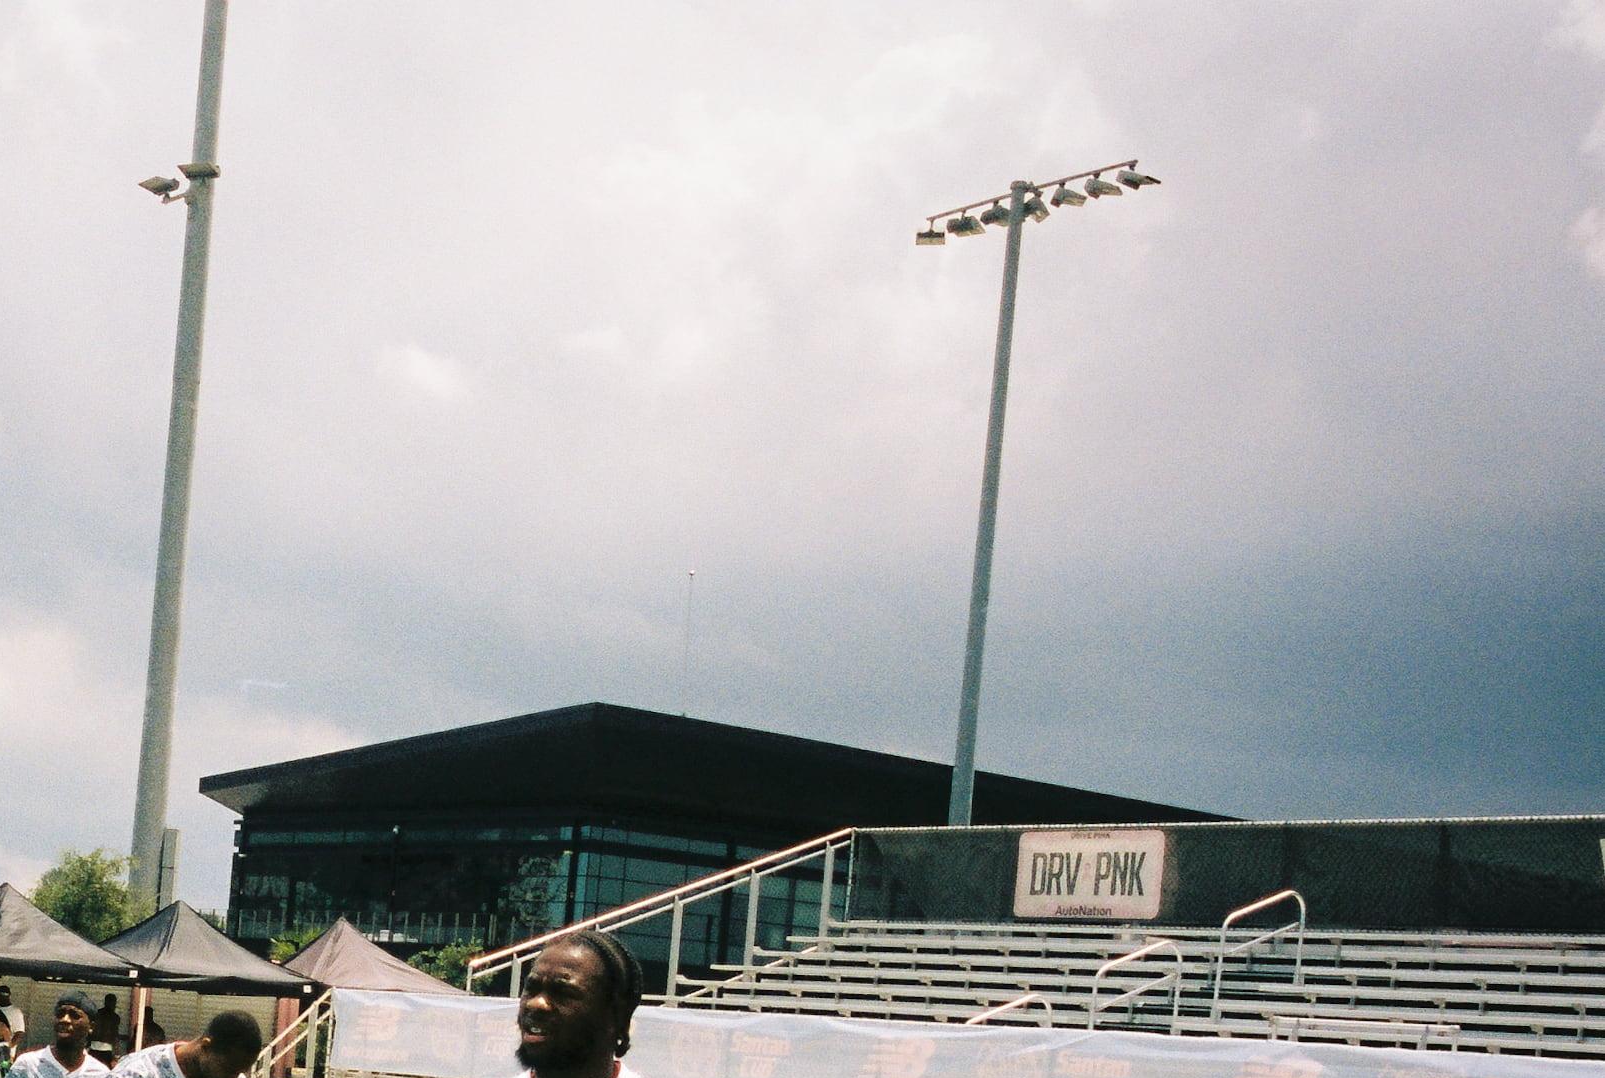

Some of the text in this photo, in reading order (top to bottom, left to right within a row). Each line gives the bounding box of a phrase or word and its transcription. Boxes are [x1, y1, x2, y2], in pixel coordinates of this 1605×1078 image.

[1029, 851, 1147, 896] DRV PNK
[1055, 905, 1112, 916] AutoNation
